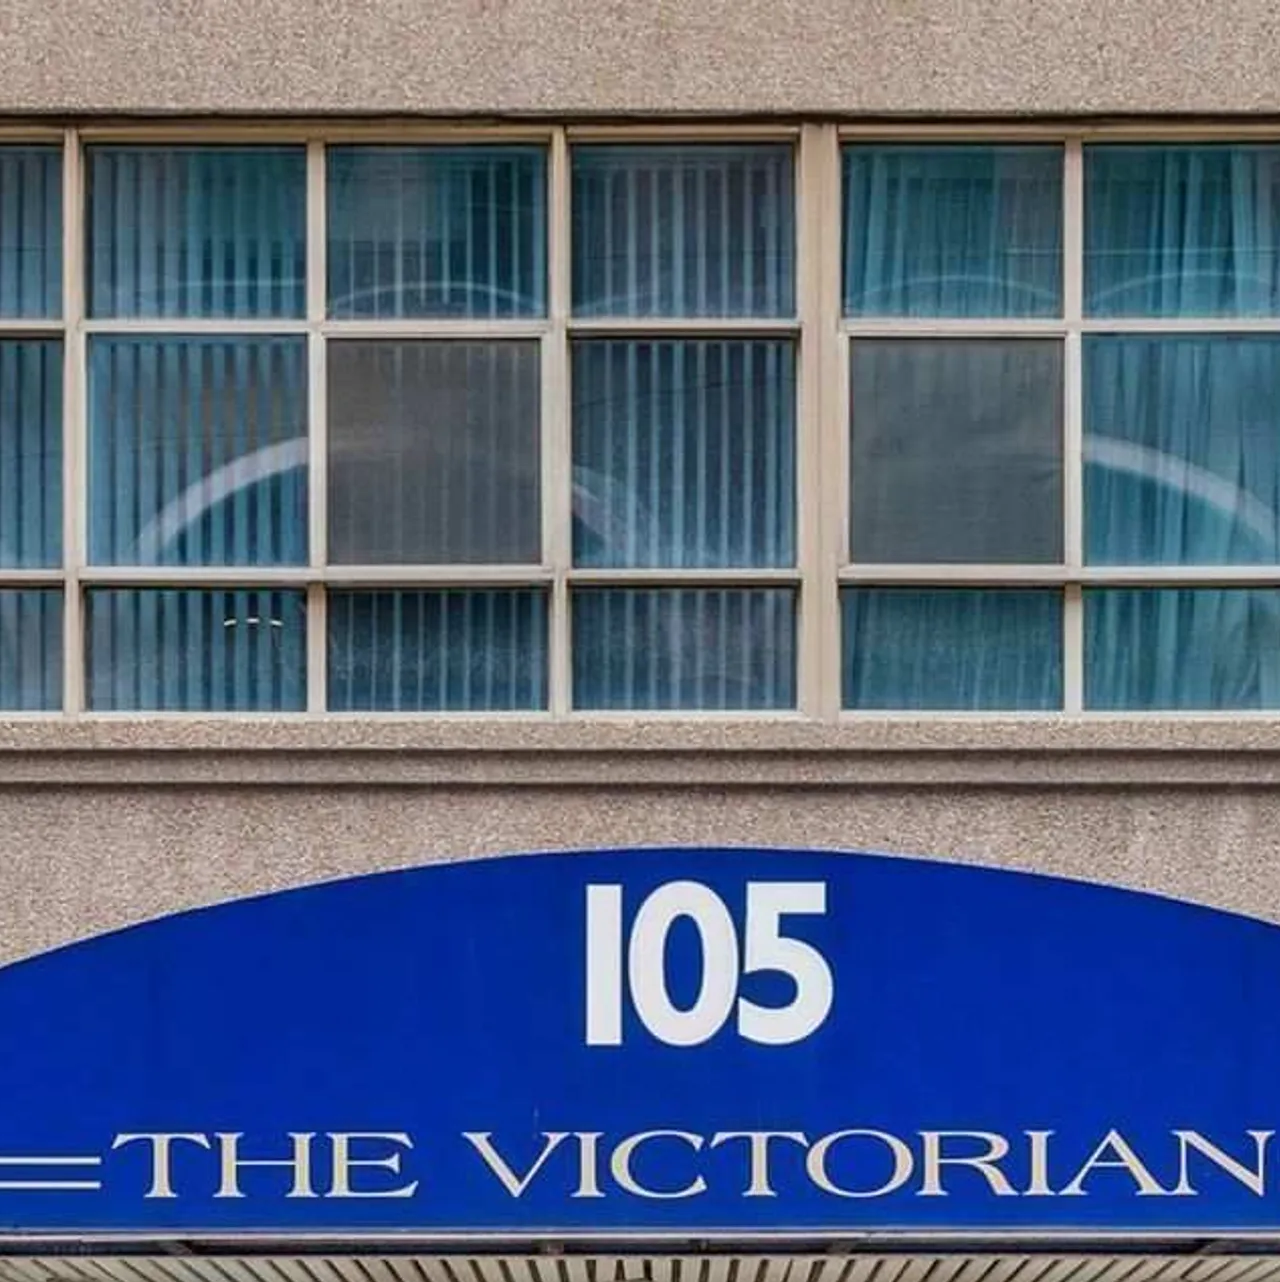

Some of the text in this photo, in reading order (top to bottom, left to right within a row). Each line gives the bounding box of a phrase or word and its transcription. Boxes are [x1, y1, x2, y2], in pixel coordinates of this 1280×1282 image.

[586, 880, 834, 1046] 105
[111, 1128, 1276, 1199] THE VICTORIAN
